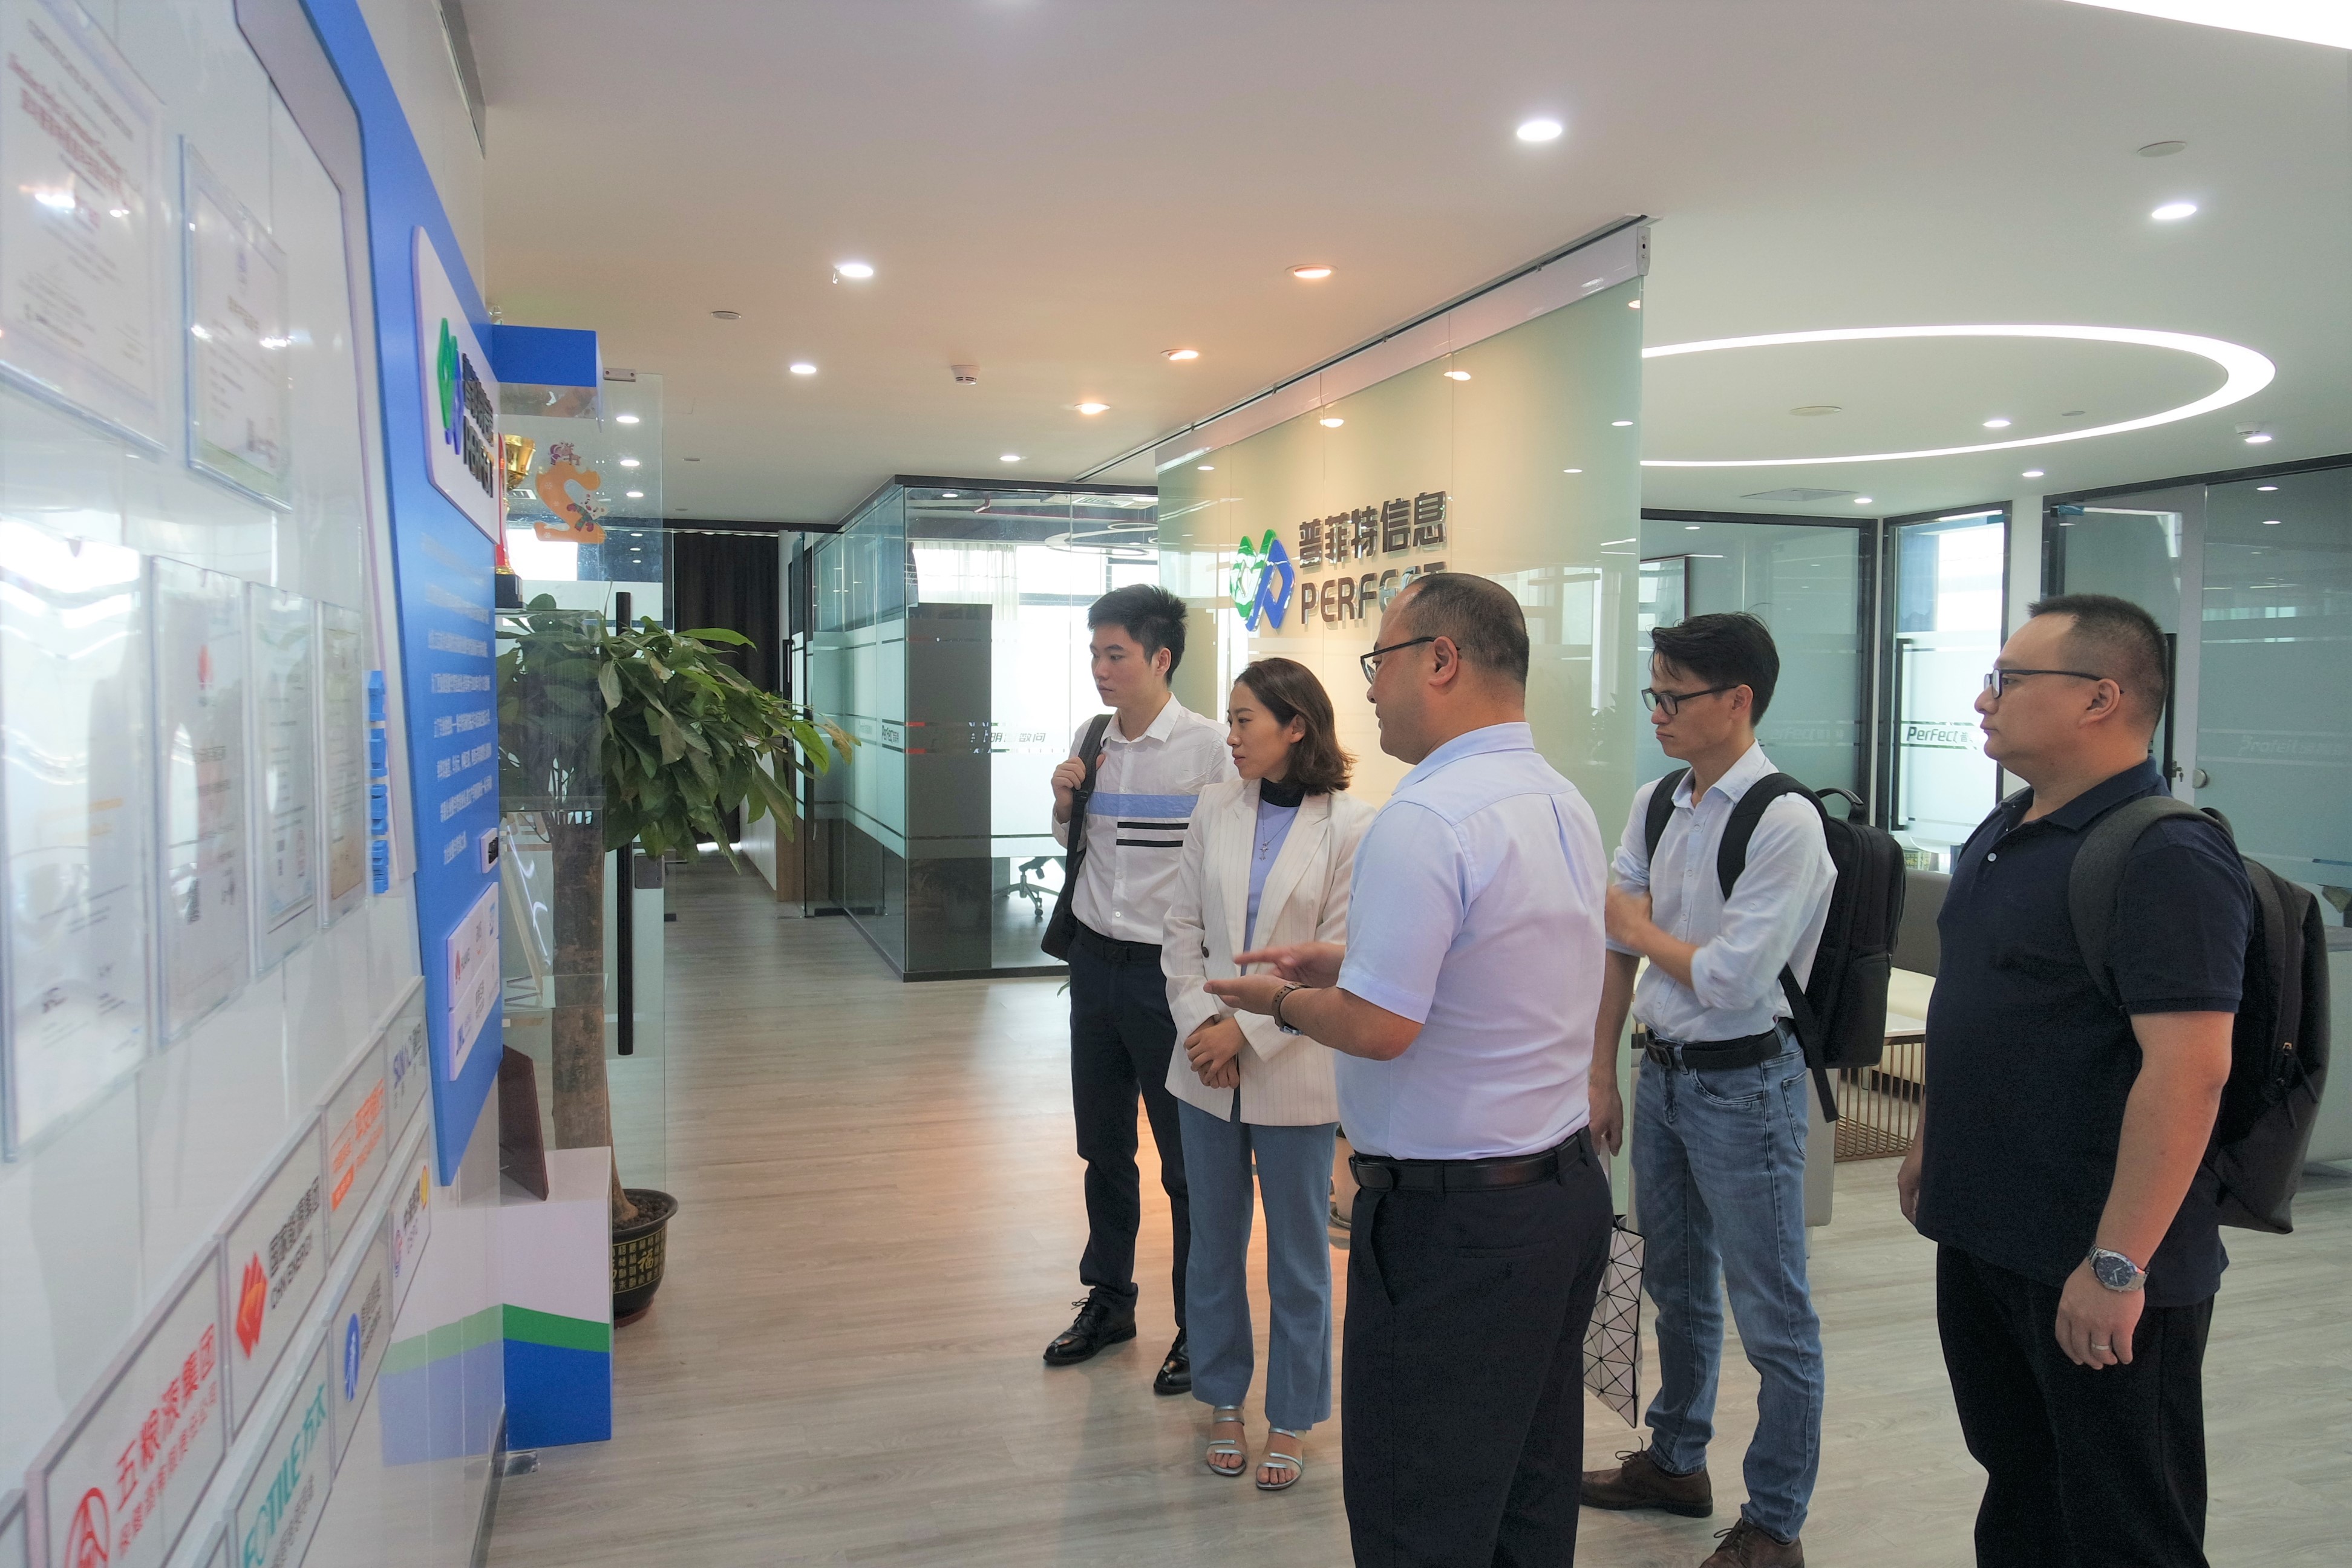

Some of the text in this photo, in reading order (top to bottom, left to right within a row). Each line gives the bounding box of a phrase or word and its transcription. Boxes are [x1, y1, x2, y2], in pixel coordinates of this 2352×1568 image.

[1299, 491, 1445, 569] 普菲特信息
